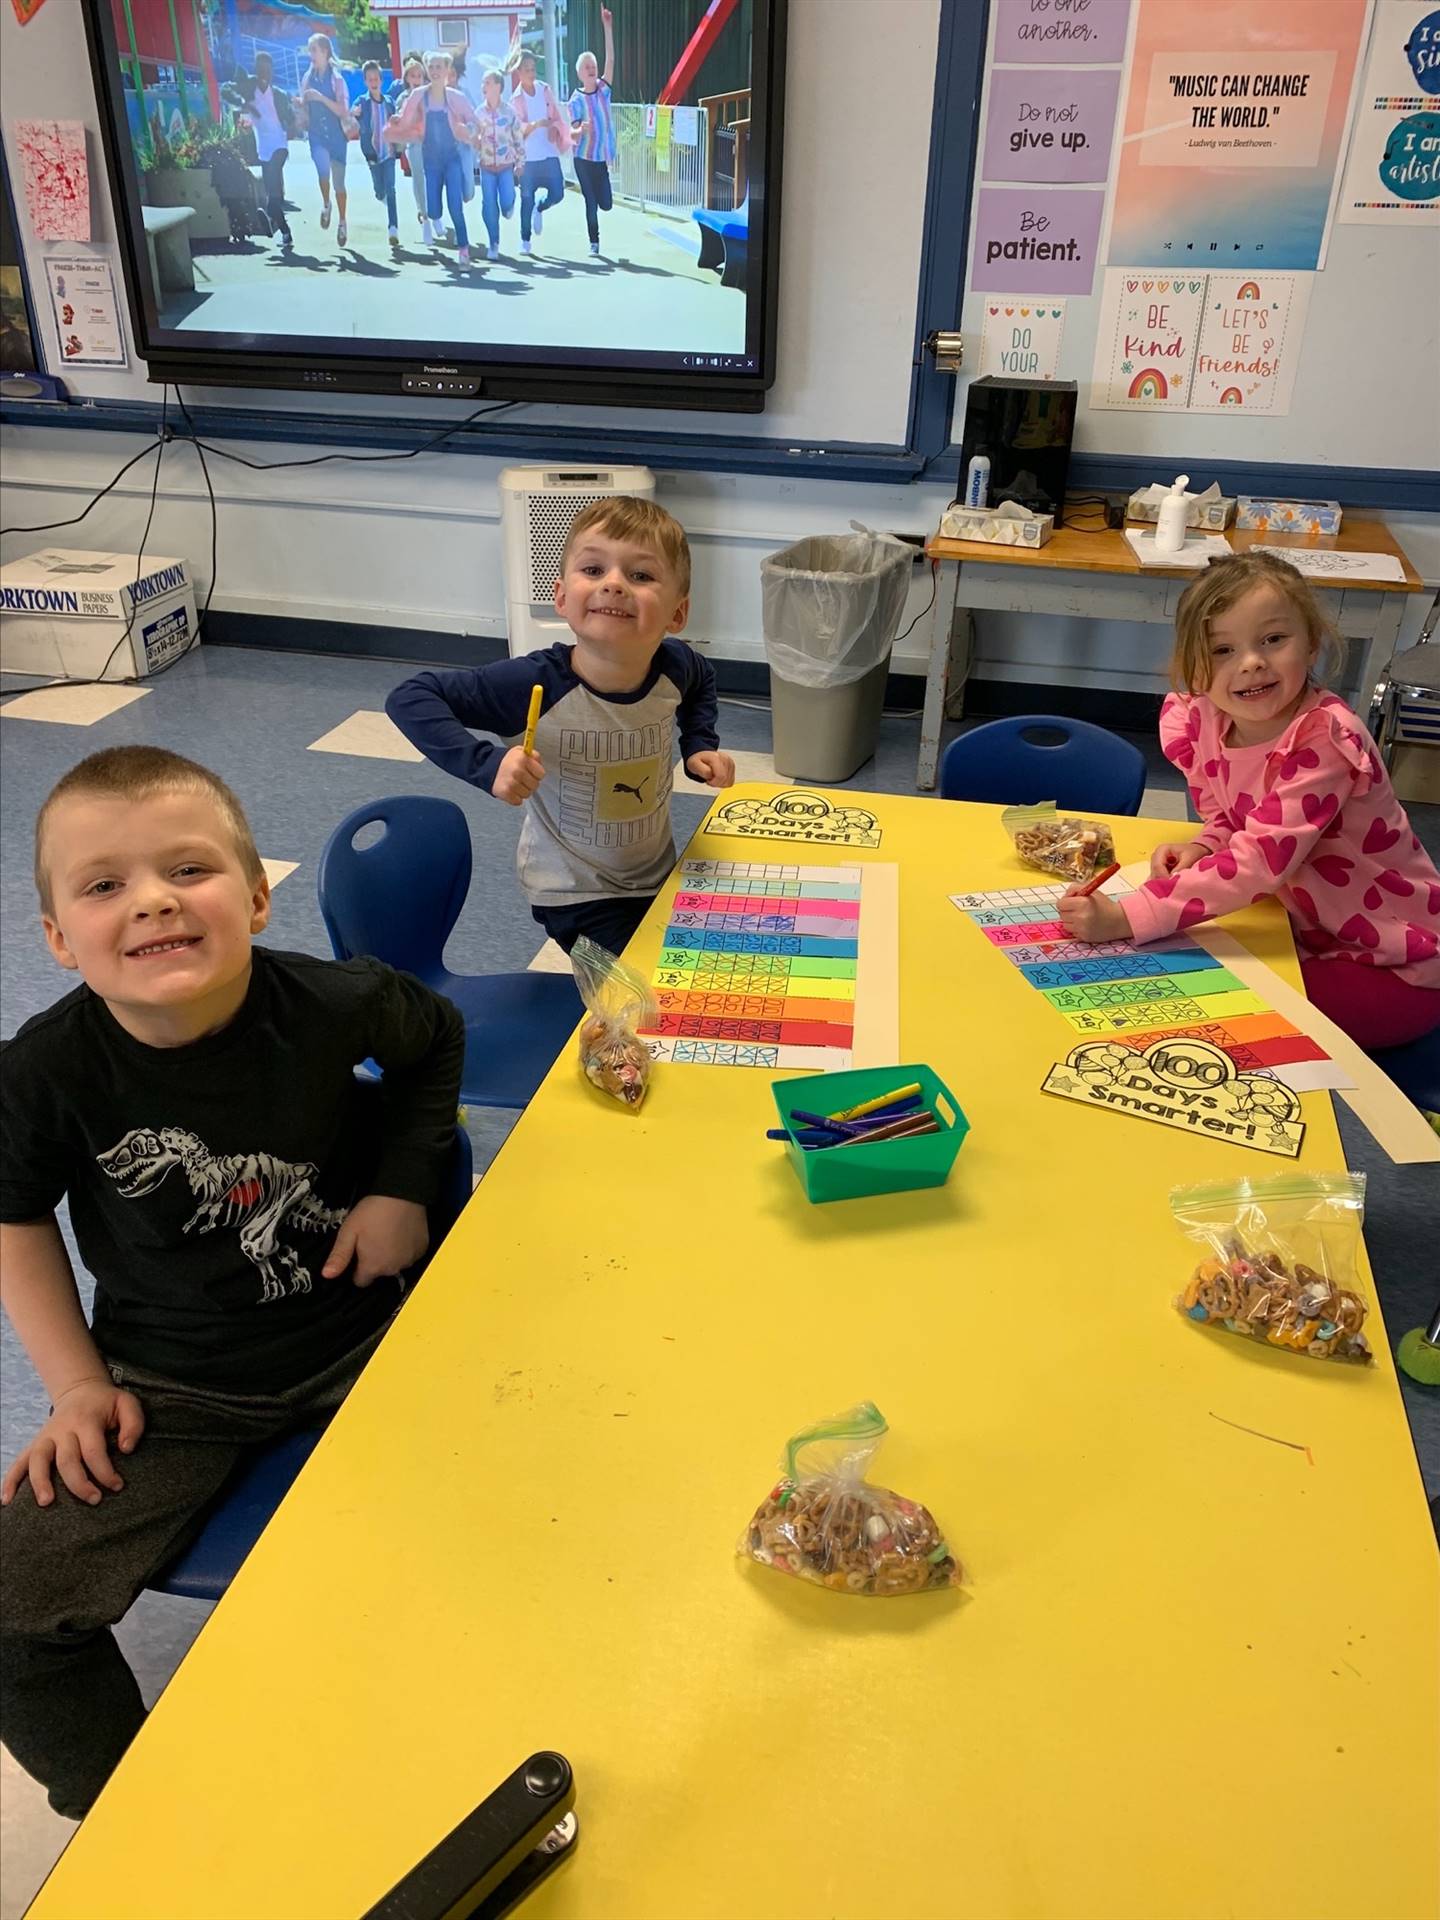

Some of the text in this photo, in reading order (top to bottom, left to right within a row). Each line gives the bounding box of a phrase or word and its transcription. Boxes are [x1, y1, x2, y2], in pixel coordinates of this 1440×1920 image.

[1018, 20, 1098, 42] another.
[1420, 27, 1430, 41] I
[1169, 74, 1310, 97] "MUSIC CAN CHANGE
[1018, 103, 1079, 123] Do not
[1192, 106, 1280, 128] THE WORLD."
[1010, 128, 1090, 152] give up.
[1188, 139, 1216, 148] Ludwig
[1218, 140, 1232, 148] van
[1233, 139, 1272, 148] Beethoven
[1404, 133, 1416, 151] I
[1019, 211, 1051, 232] Be
[986, 237, 1081, 264] patient.
[1147, 304, 1170, 329] BE
[1222, 308, 1269, 329] LET'S
[1012, 328, 1032, 349] DO
[1124, 335, 1186, 358] Kind
[1232, 334, 1251, 354] BE
[1001, 351, 1039, 373] YOUR
[1199, 355, 1279, 378] Friends!
[127, 564, 186, 604] YORKTOWN
[81, 592, 114, 604] BUSINESS
[83, 603, 109, 614] PAPERS
[560, 723, 662, 763] PUMA
[777, 800, 829, 816] 100
[737, 825, 851, 842] Smarter!
[761, 817, 825, 829] Days
[673, 953, 684, 963] 50
[1061, 994, 1076, 1005] 50
[1082, 1016, 1096, 1027] 40
[1153, 1050, 1228, 1085] 100
[1125, 1074, 1219, 1110] Days
[1088, 1083, 1257, 1140] Smarter!
